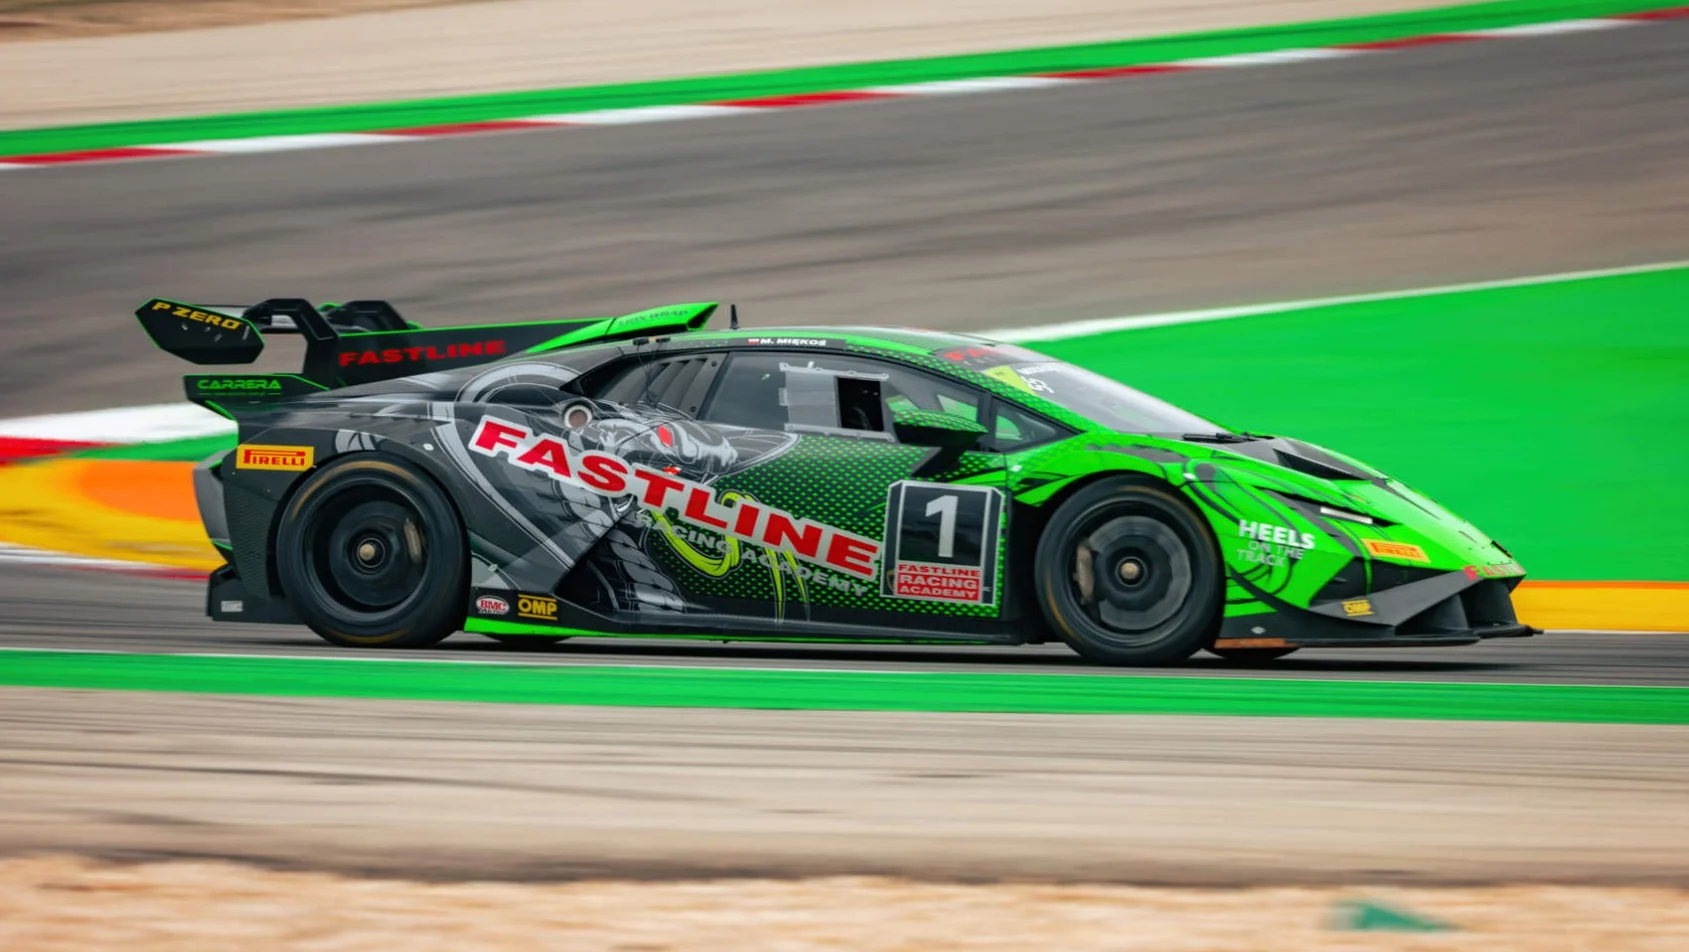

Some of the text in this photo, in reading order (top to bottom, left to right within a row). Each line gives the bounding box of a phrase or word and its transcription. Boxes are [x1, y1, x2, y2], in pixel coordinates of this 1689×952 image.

[152, 301, 242, 330] P ZERO
[339, 340, 506, 366] FASTLINE
[197, 379, 282, 390] CARRERA
[244, 448, 306, 467] PIRELLI
[475, 420, 879, 576] FASTLINE
[925, 494, 959, 558] 1
[1238, 519, 1316, 550] HEELS
[635, 511, 869, 598] RACING ACADEMY
[1237, 549, 1285, 568] TRACK
[1248, 540, 1305, 560] ON THE
[898, 564, 981, 577] FASTLINE
[899, 574, 978, 589] RACING
[900, 585, 976, 599] ACADEMY
[480, 600, 507, 612] BMC
[518, 598, 557, 615] OMP
